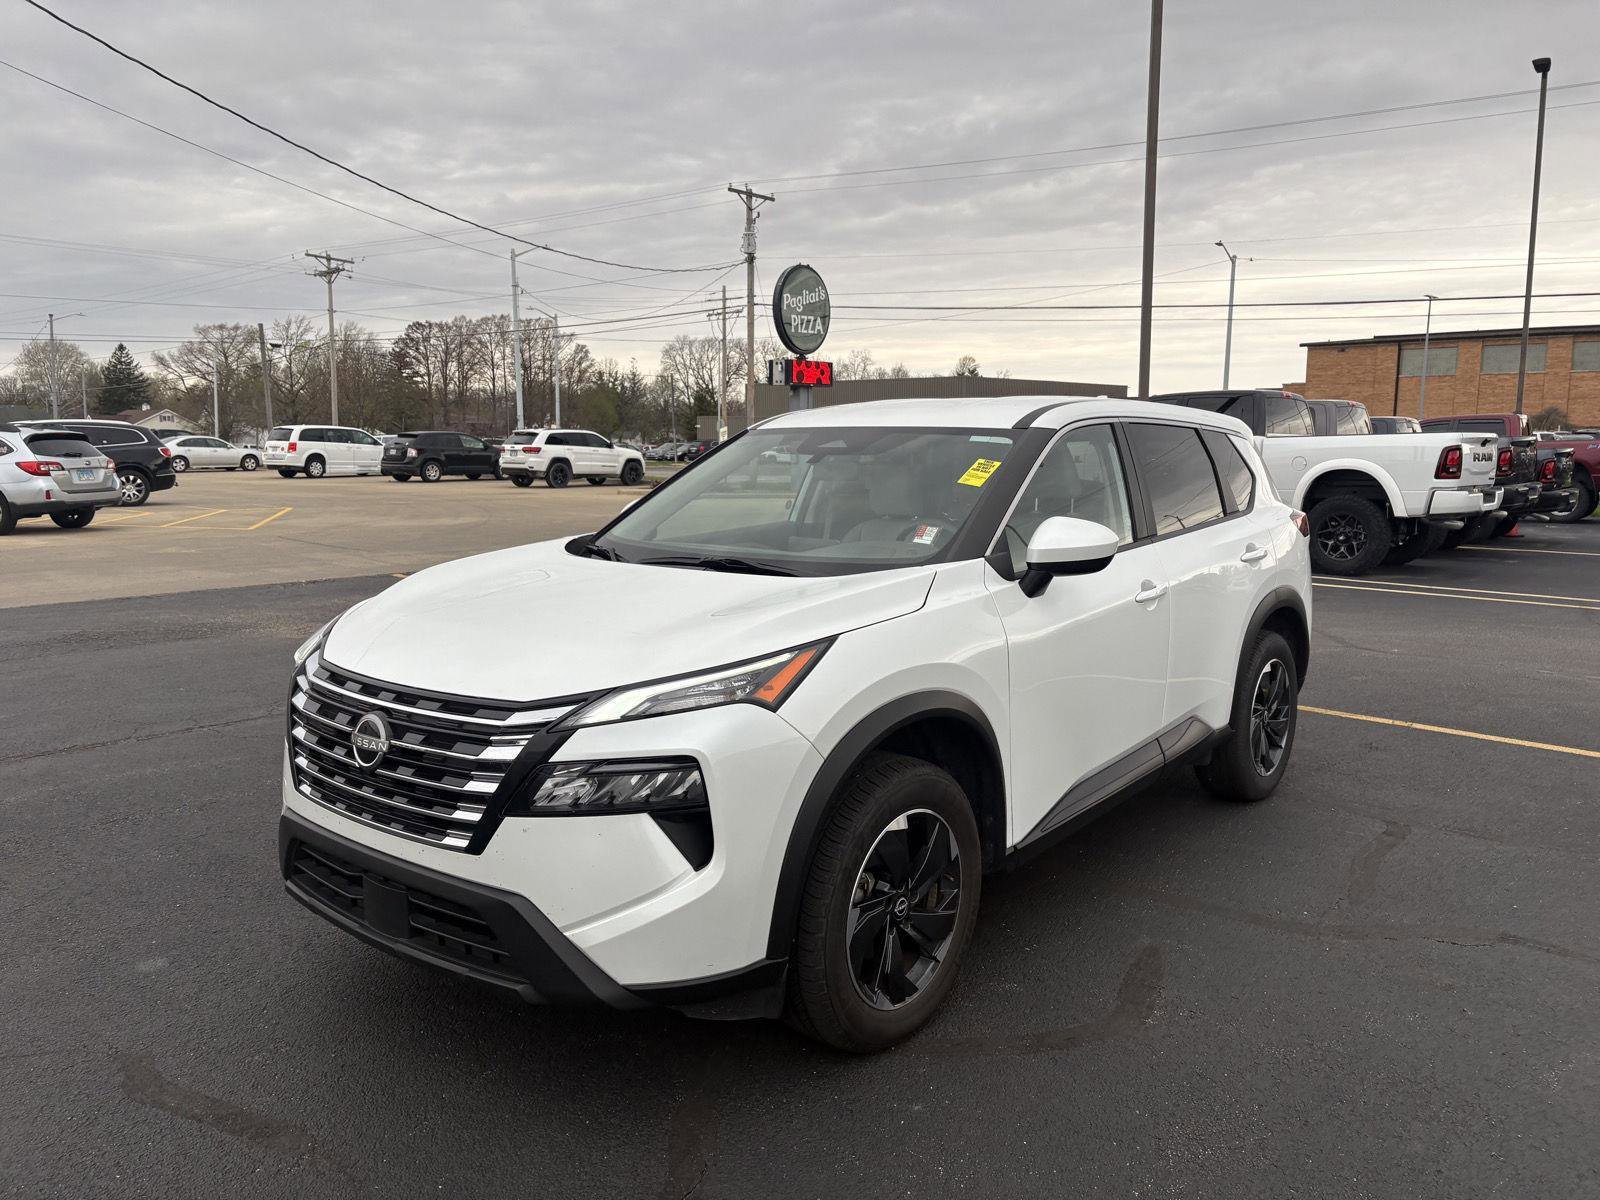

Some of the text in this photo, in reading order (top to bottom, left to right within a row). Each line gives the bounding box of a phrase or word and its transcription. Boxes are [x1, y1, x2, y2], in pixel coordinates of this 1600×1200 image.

[783, 286, 826, 312] Pagliai's
[791, 314, 824, 335] PIZZA
[1472, 452, 1493, 463] RAM
